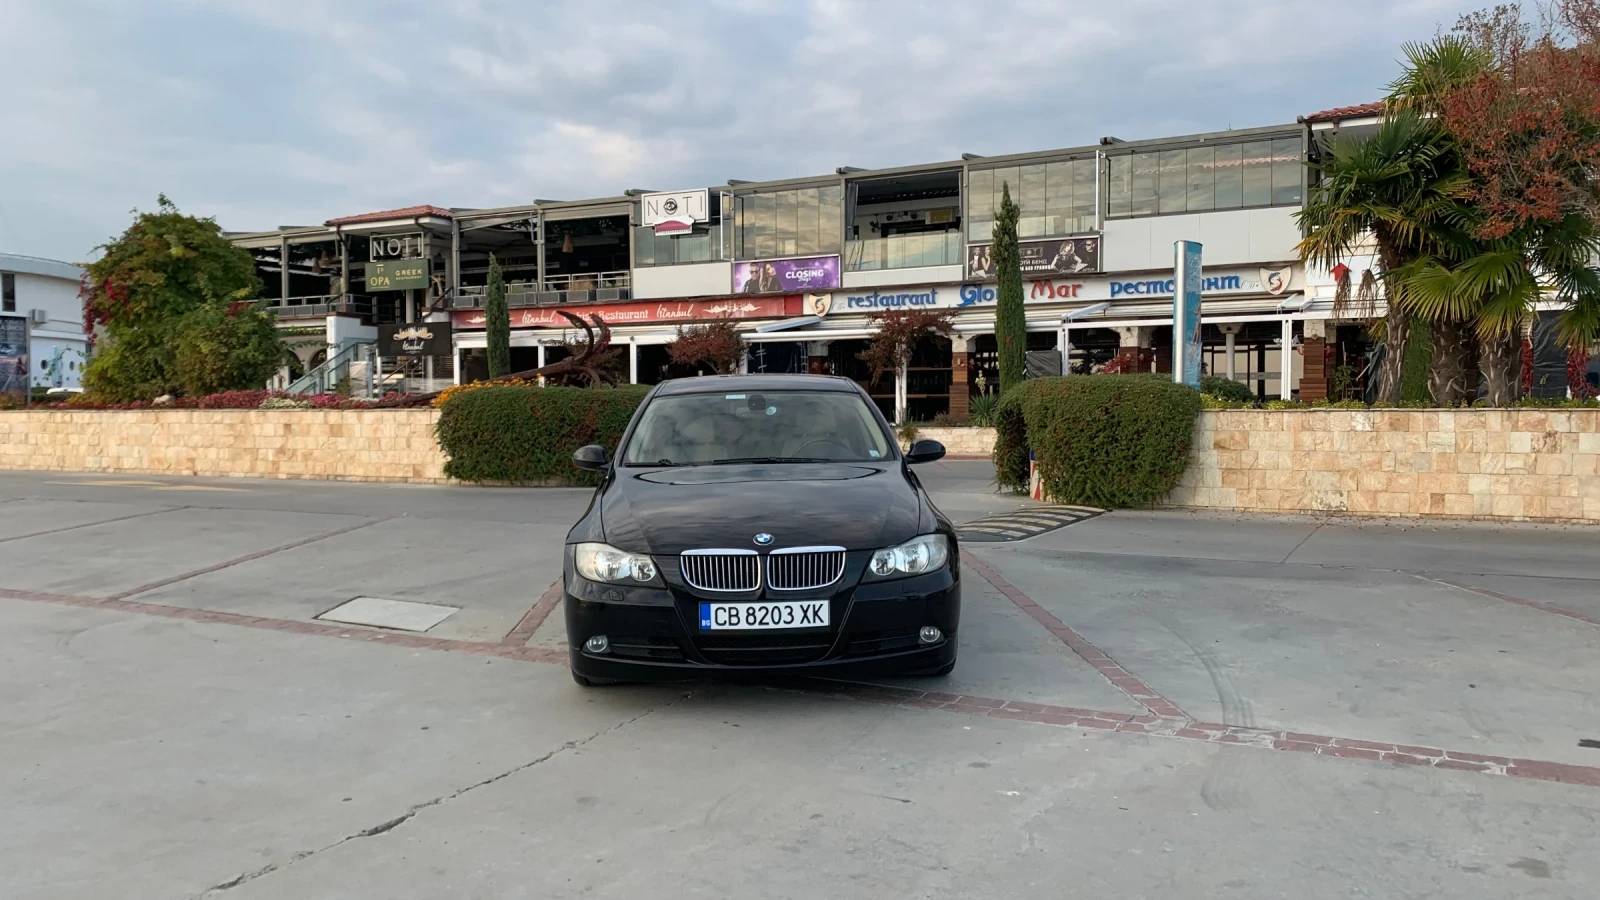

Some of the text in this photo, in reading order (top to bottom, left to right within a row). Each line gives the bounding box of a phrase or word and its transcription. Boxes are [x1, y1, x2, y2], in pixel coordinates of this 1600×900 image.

[647, 195, 702, 217] NOTI
[373, 236, 421, 256] NOTI
[395, 268, 423, 276] GREEK
[785, 269, 824, 279] CLOSING
[370, 276, 390, 286] OPA
[847, 289, 938, 308] restaurant
[1030, 279, 1082, 299] Mar
[599, 310, 648, 321] Restaurant
[714, 603, 824, 626] CB 8203 XK
[701, 619, 711, 627] BG
